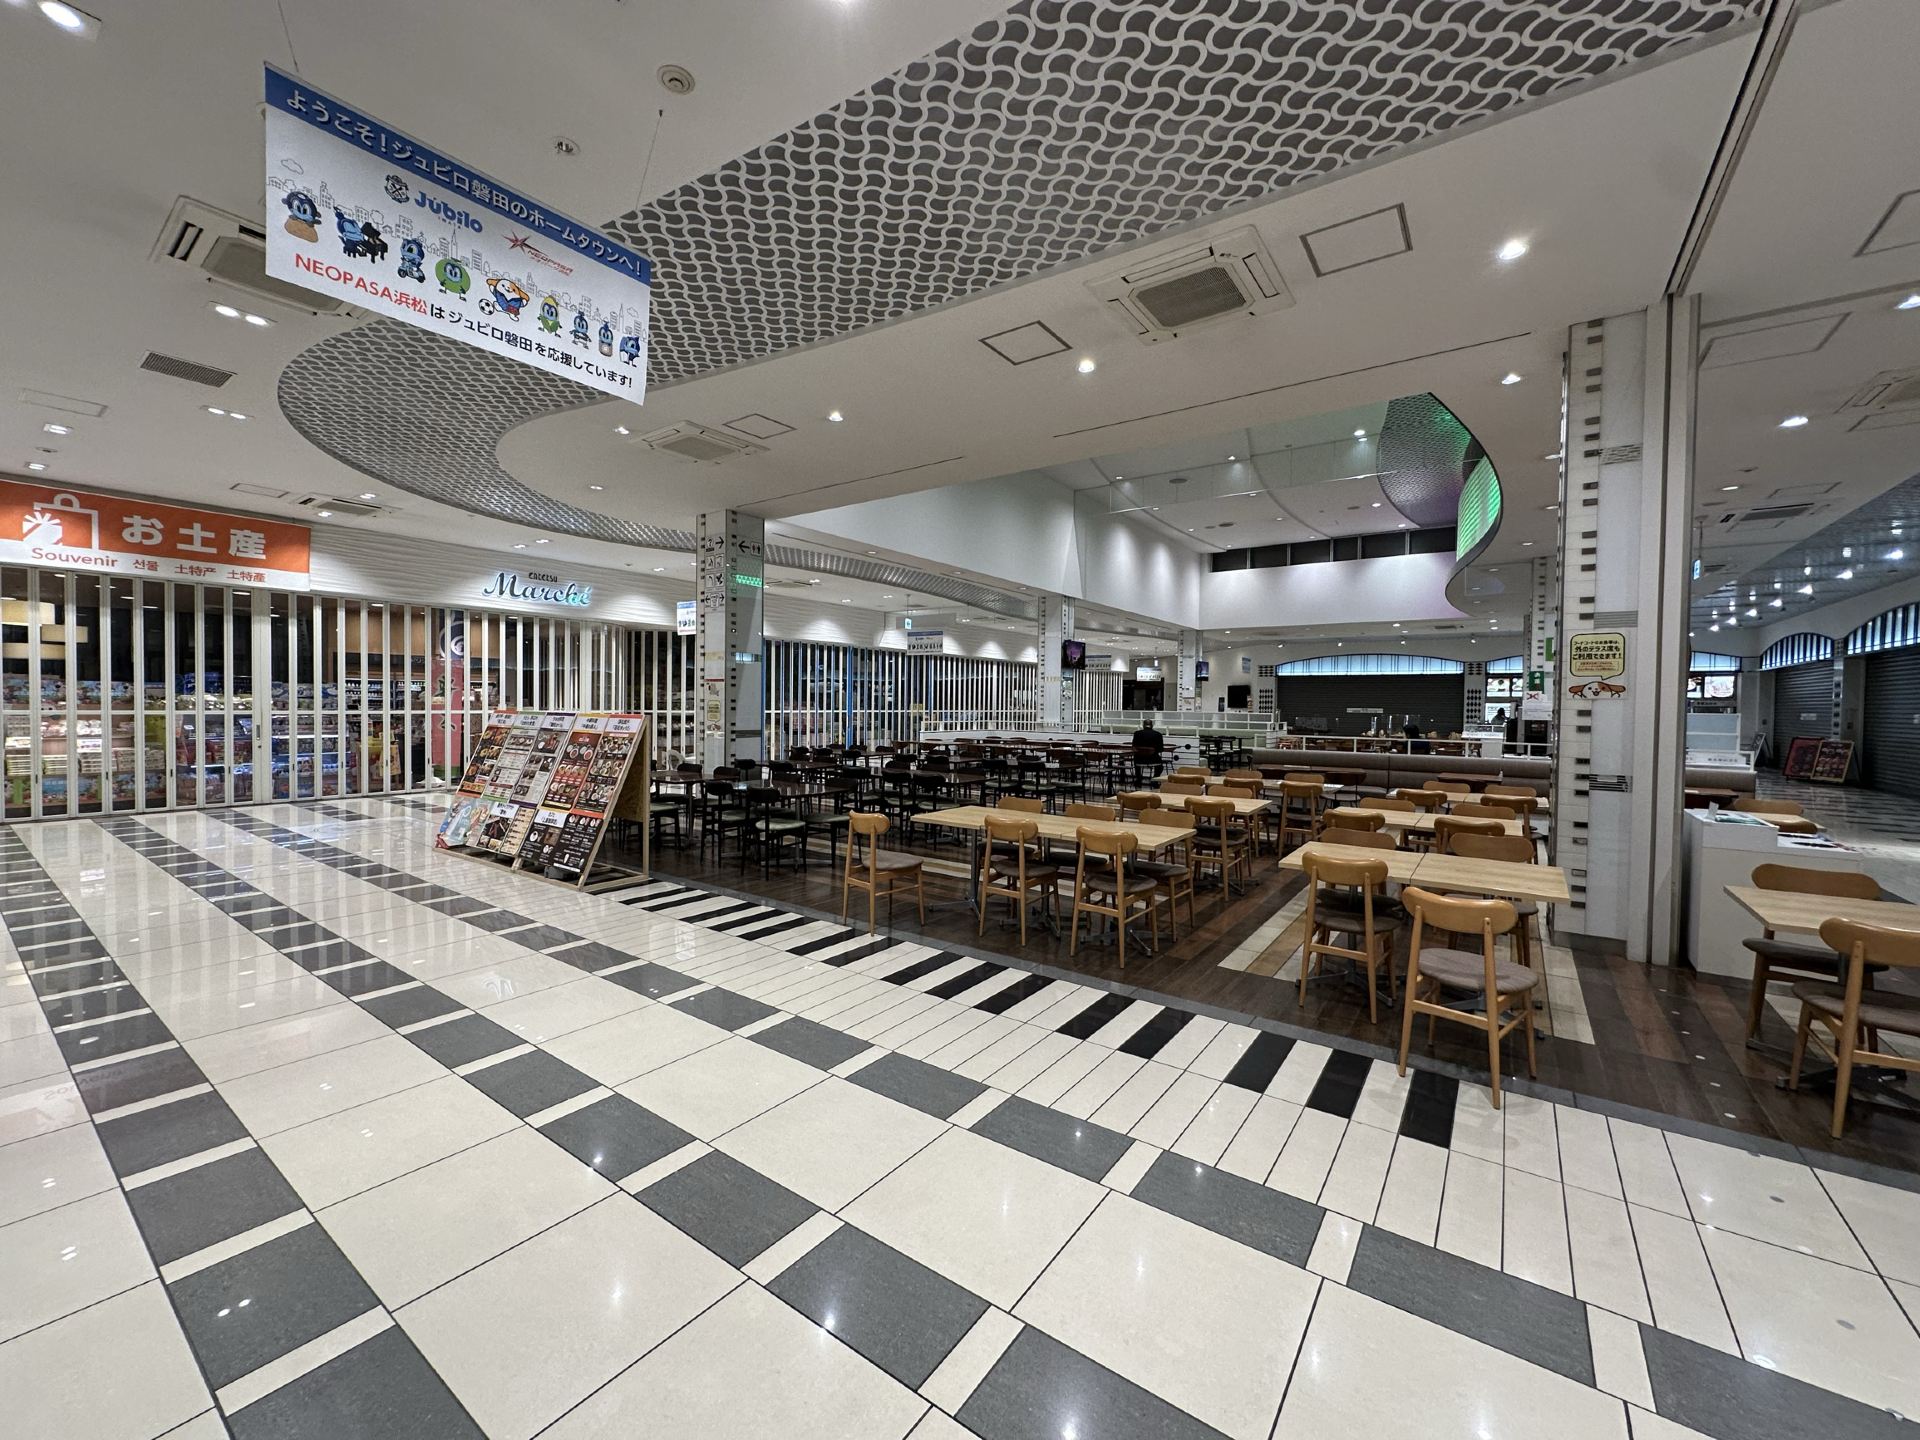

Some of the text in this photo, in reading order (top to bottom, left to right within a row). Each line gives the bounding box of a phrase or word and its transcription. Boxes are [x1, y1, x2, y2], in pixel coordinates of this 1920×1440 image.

[527, 249, 574, 273] NEOPASA
[121, 514, 267, 560] お土産
[31, 546, 118, 568] Souvenir
[133, 558, 160, 572] 선물
[174, 563, 216, 578] 土特产
[528, 571, 558, 583] entetsu
[481, 571, 593, 607] Marché
